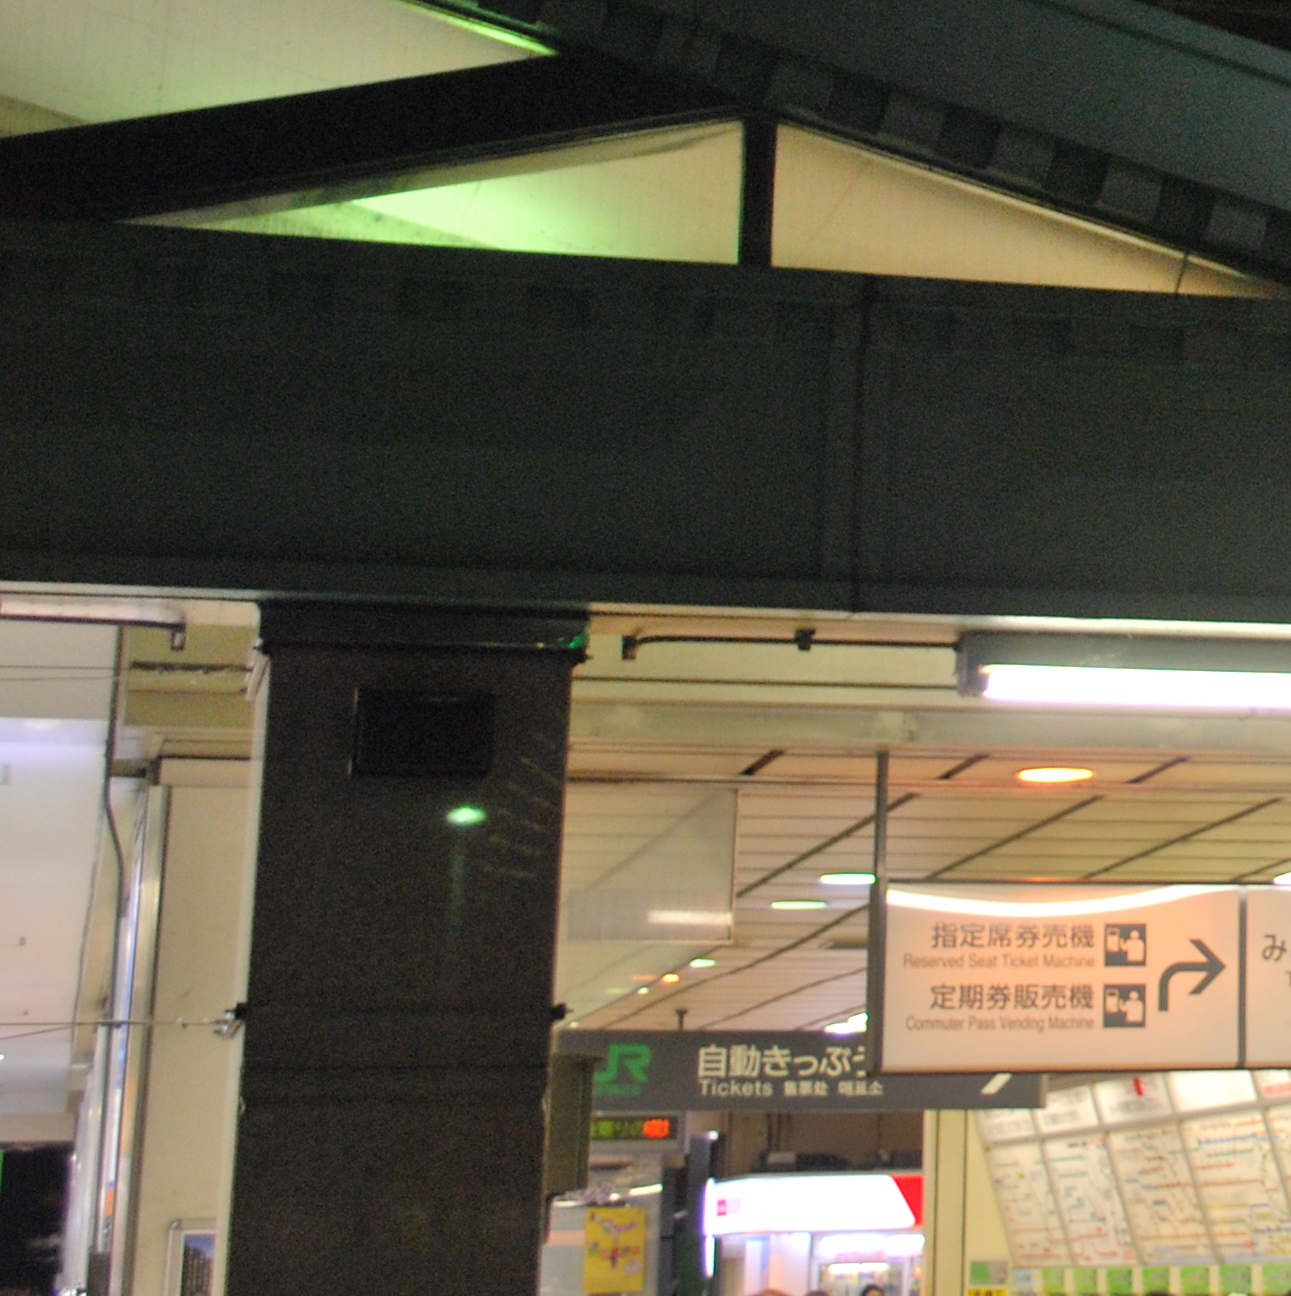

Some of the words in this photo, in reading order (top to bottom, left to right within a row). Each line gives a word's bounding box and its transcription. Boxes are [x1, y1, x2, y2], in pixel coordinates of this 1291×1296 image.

[931, 922, 1095, 949] 指定席券売機
[903, 953, 964, 969] Reserved
[969, 953, 997, 968] Seat
[1003, 953, 1039, 968] Ticket
[1043, 953, 1095, 968] Machine
[930, 983, 1095, 1011] 定期券販売機
[905, 1015, 963, 1031] Commuter
[968, 1015, 996, 1031] Pass
[1000, 1015, 1044, 1033] Vending
[1048, 1015, 1095, 1030] Machine
[699, 1078, 774, 1096] Tickets
